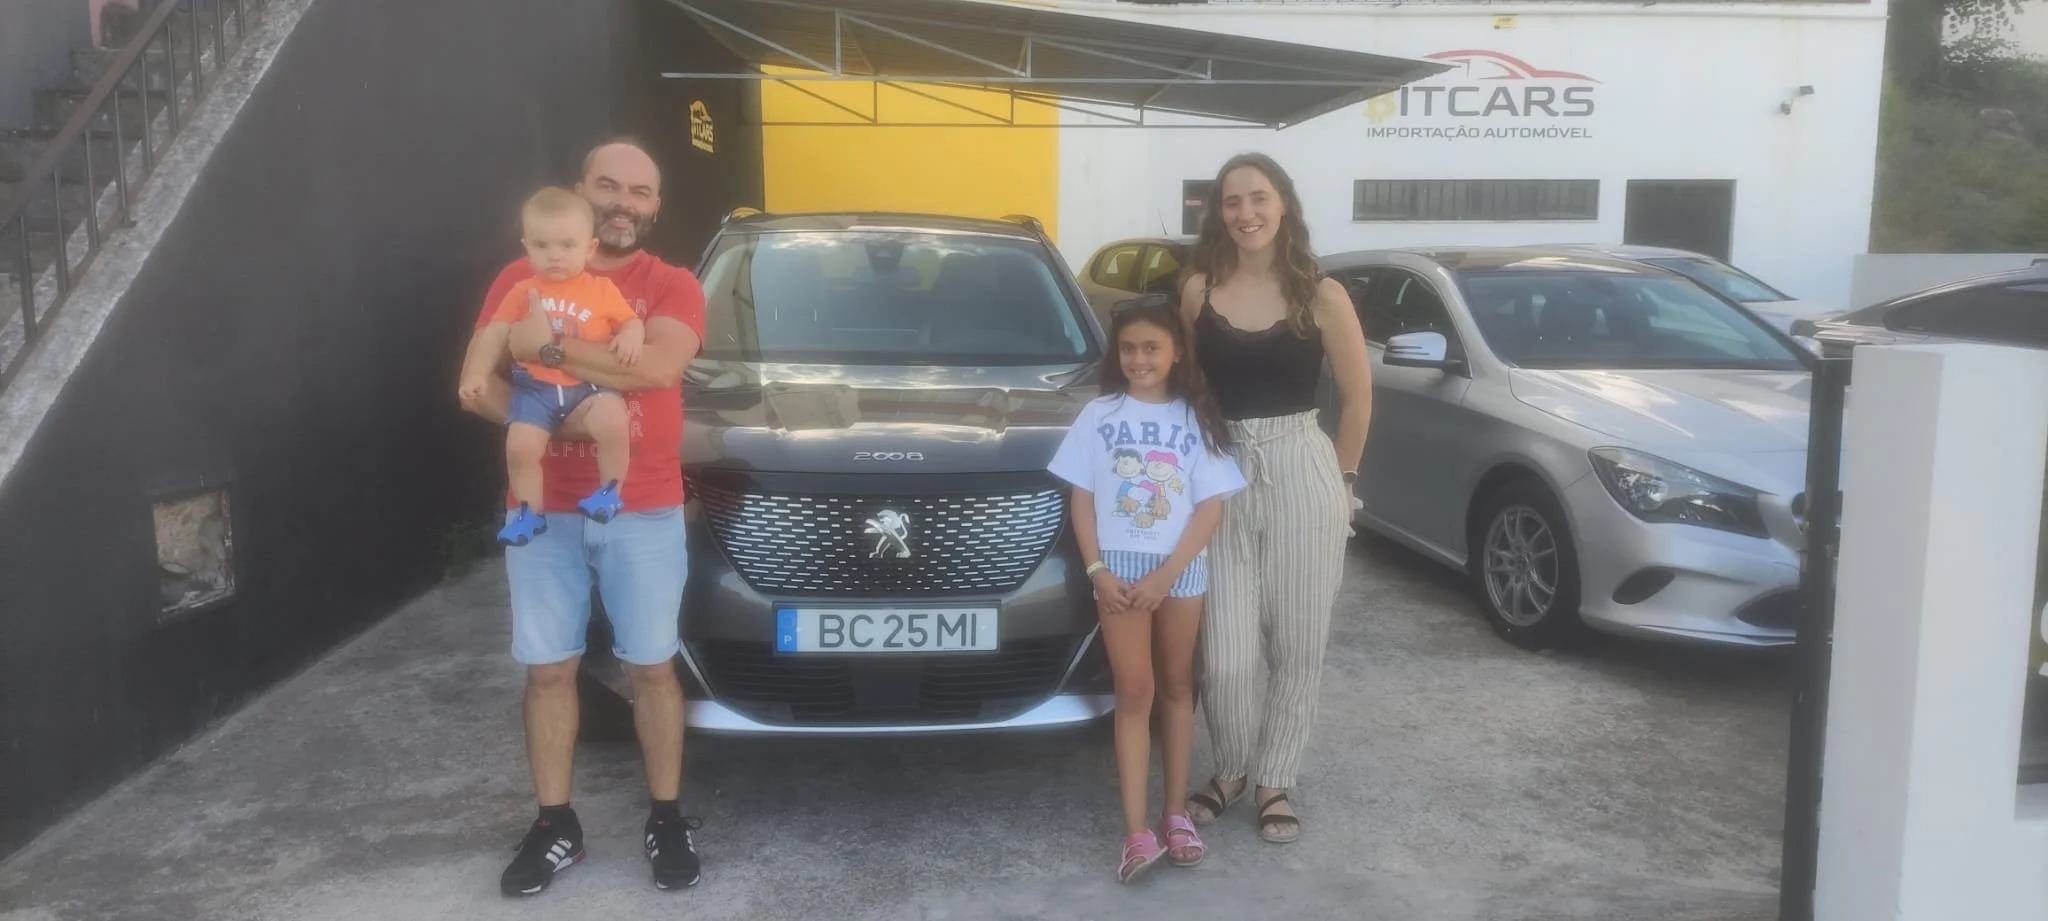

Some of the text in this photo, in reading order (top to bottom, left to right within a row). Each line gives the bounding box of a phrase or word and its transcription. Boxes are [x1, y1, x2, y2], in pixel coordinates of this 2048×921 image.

[1367, 124, 1593, 141] IMPORTAÇÃO AUTOMÓVEL
[529, 297, 592, 323] MILE
[1097, 420, 1198, 457] PARIS
[853, 451, 924, 461] 2008
[784, 635, 792, 645] P
[819, 613, 977, 648] BC 25 MI
